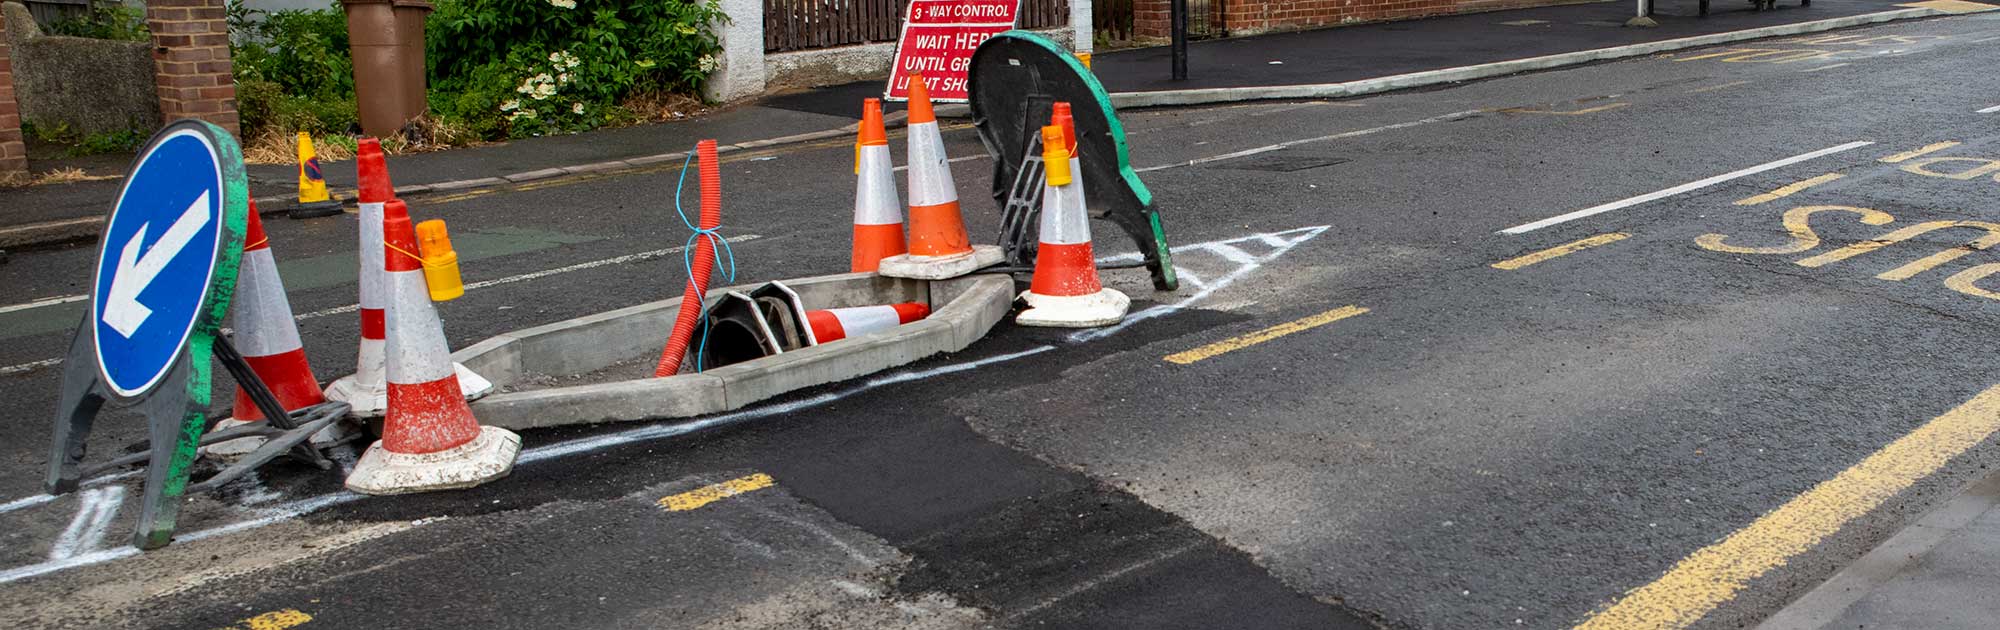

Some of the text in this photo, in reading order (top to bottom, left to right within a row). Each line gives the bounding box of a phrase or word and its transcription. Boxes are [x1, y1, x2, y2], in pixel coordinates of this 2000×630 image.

[914, 8, 922, 19] 3
[954, 4, 1009, 17] CONTROL
[916, 35, 951, 49] WAIT
[905, 56, 946, 71] UNTIL
[896, 76, 941, 91] LIHT
